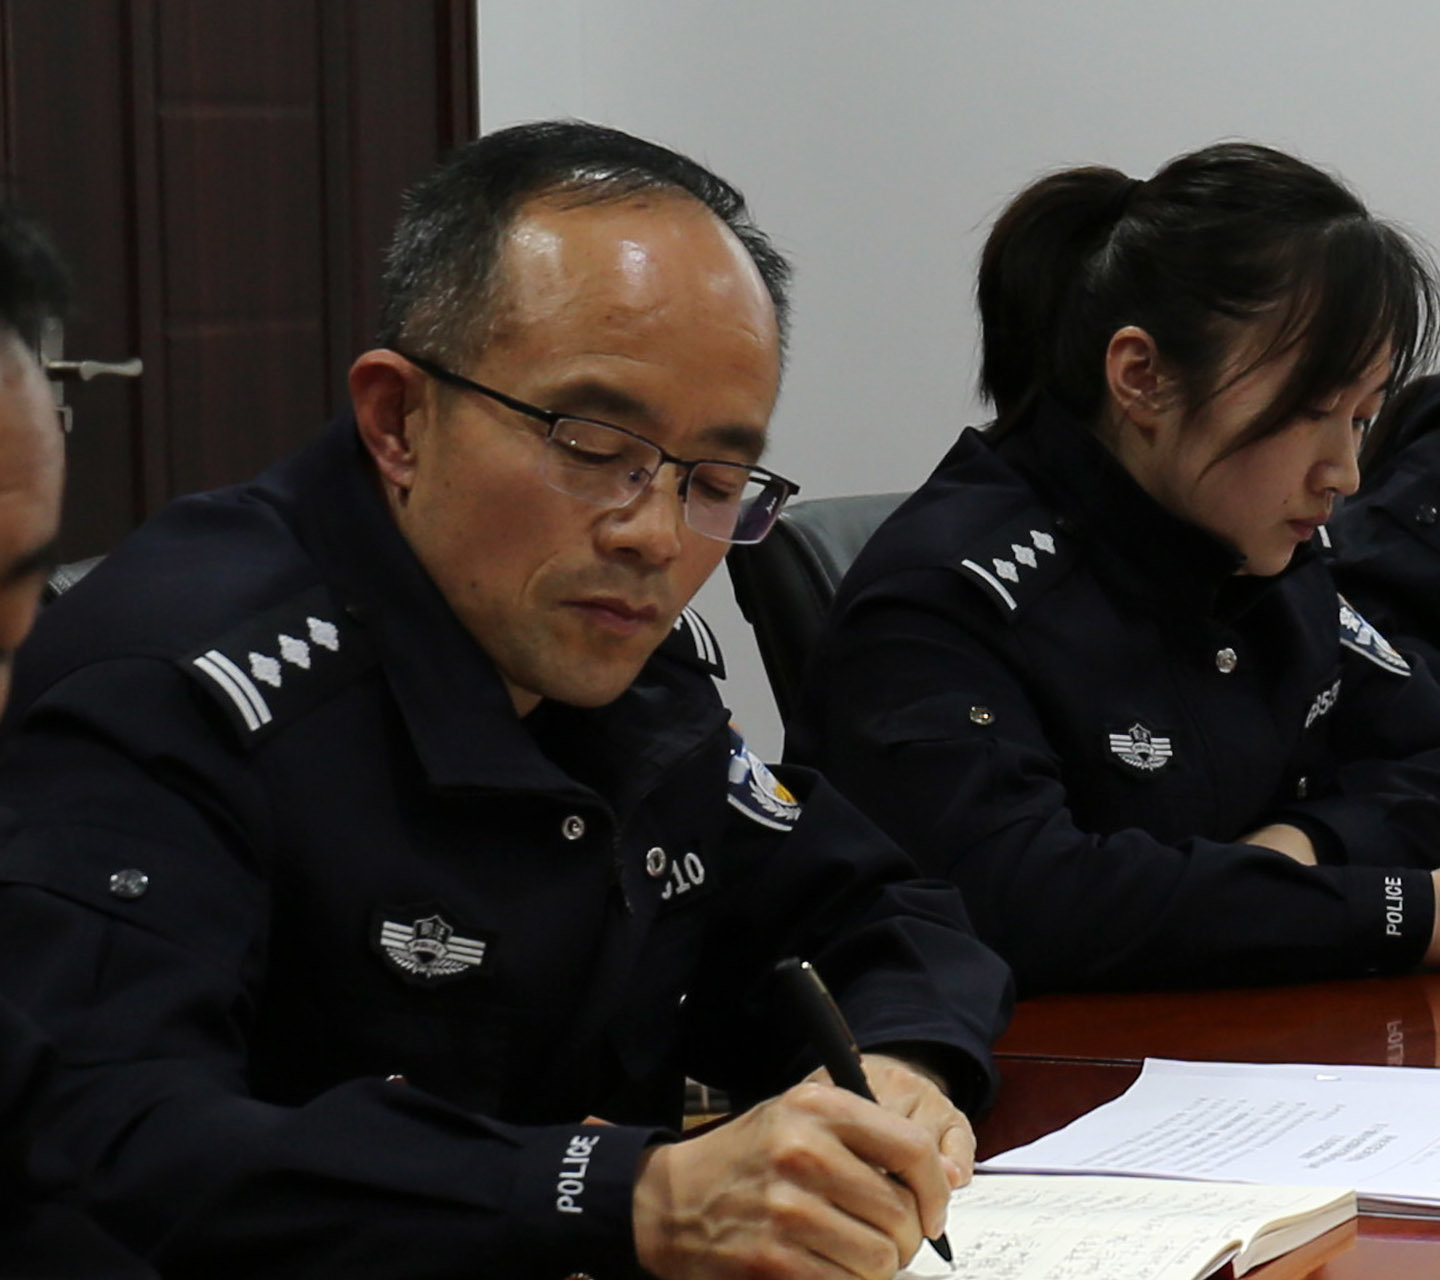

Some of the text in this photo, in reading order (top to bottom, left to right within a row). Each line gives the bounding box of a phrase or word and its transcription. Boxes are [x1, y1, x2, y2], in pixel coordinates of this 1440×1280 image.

[662, 852, 705, 899] 10
[1385, 876, 1403, 935] POLICE
[556, 1135, 600, 1213] POLICE
